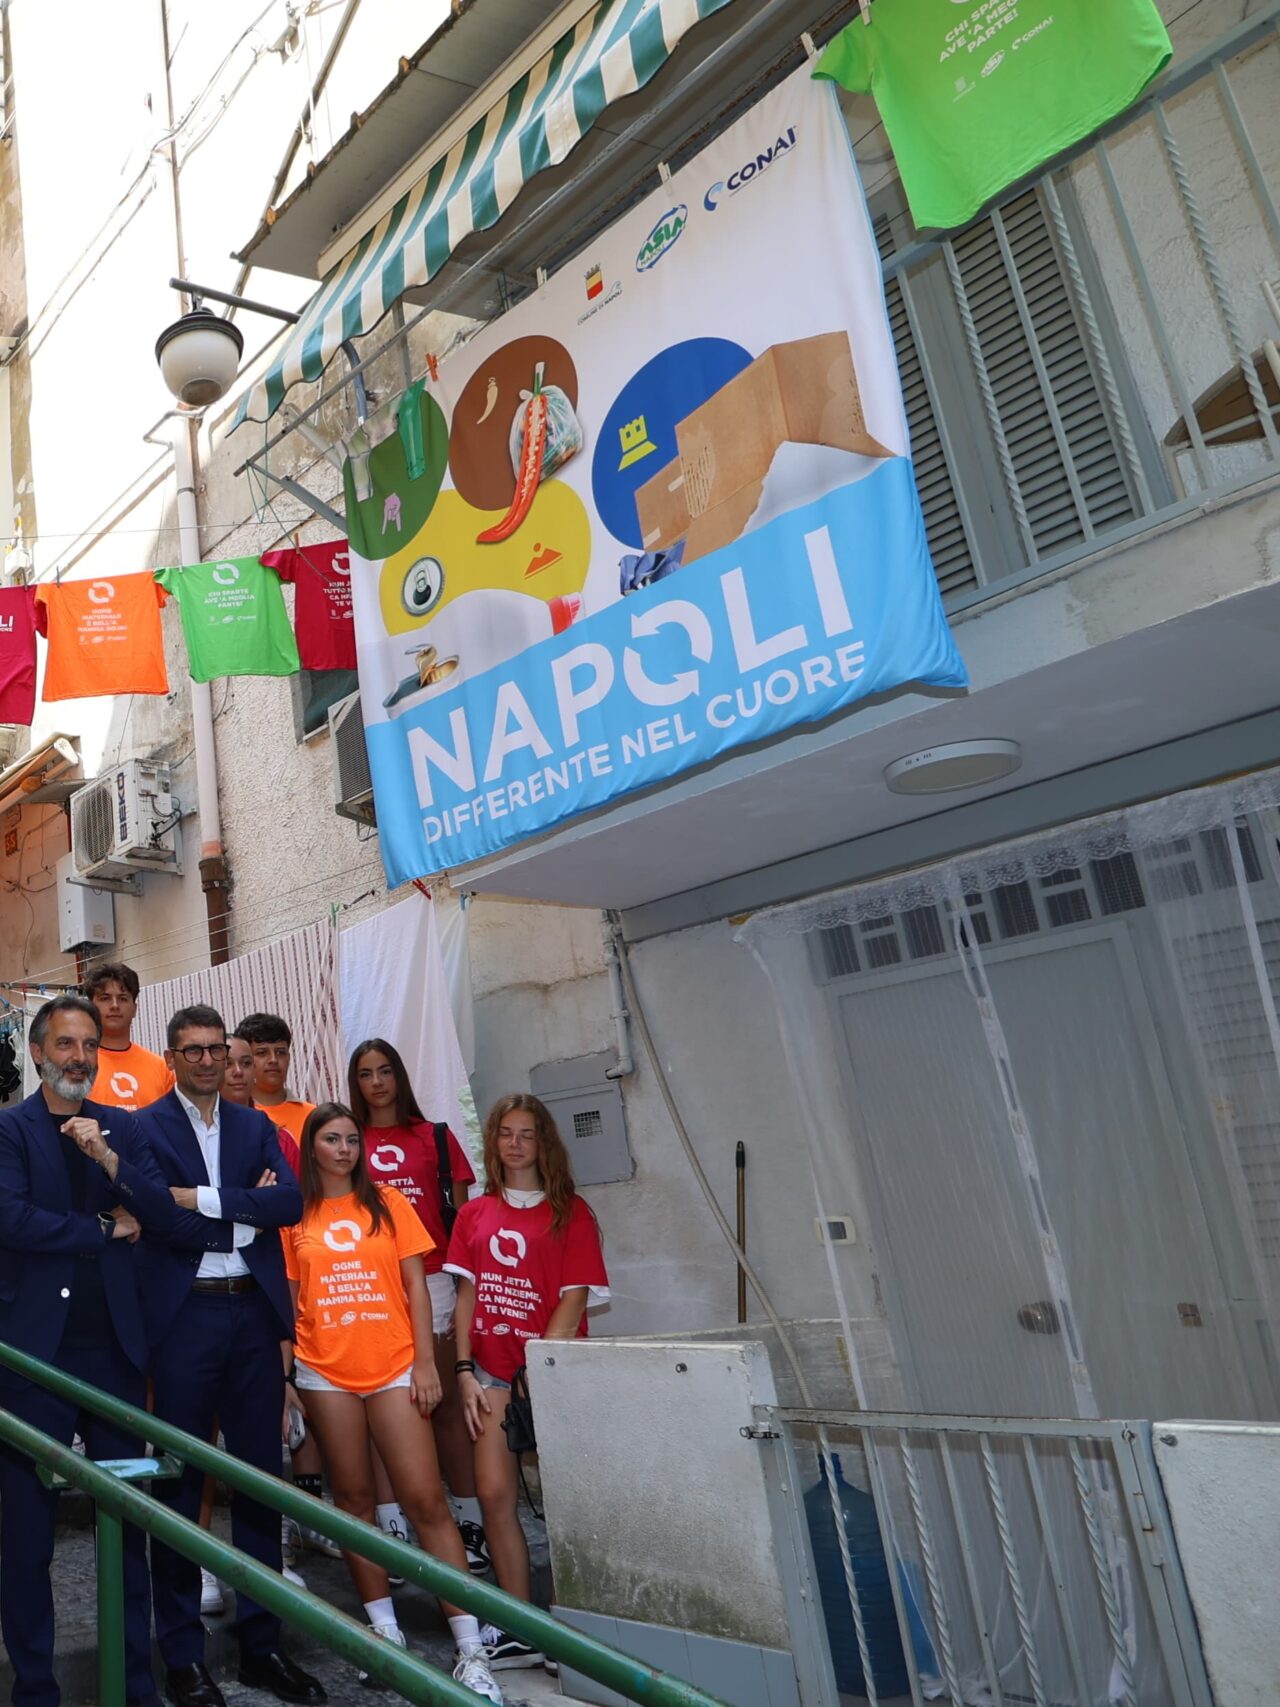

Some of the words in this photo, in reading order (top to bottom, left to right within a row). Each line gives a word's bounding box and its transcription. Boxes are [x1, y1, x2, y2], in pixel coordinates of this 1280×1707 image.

[944, 20, 968, 42] CHI
[967, 8, 1018, 53] PARTE!
[1022, 16, 1054, 42] CONAI
[939, 35, 967, 63] AVE
[726, 126, 797, 191] CONAI
[639, 216, 684, 261] ASIA
[407, 524, 854, 809] NAPOLI
[423, 743, 613, 844] DIFFERENTE
[621, 713, 697, 765] NEL
[706, 640, 865, 729] CUORE
[117, 772, 128, 842] BEKO
[116, 1105, 137, 1113] NE
[332, 1261, 362, 1271] OGNE
[320, 1271, 377, 1284] MATERIALE
[337, 1283, 371, 1293] BELL'A
[480, 1272, 502, 1283] NUN
[504, 1275, 532, 1289] JETTÀ
[317, 1294, 355, 1307] MAMMA
[357, 1293, 386, 1302] SOJA!
[478, 1294, 492, 1303] CA
[494, 1295, 536, 1311] NFACCIA
[479, 1283, 503, 1292] UTTO
[505, 1287, 542, 1303] NZIEME,
[485, 1304, 499, 1314] TE
[500, 1307, 528, 1320] VENE!
